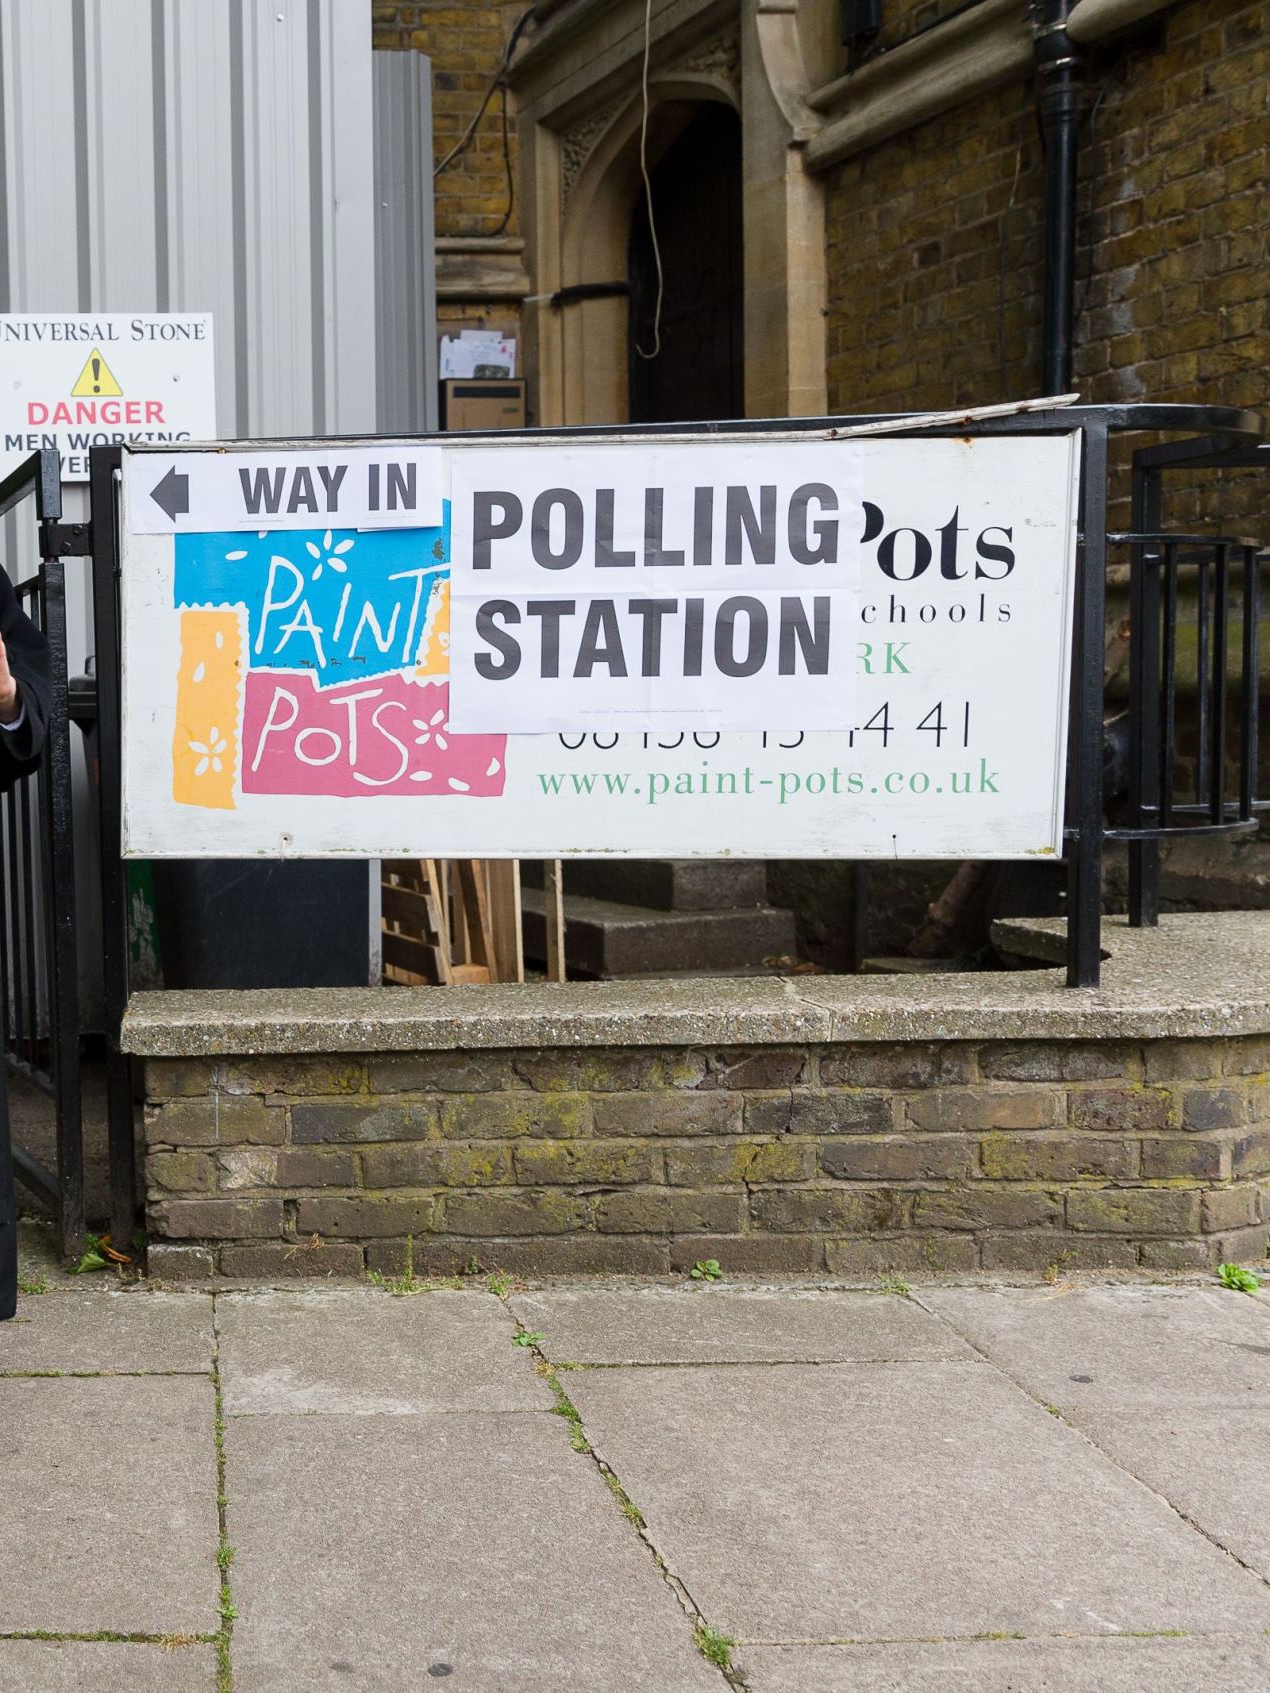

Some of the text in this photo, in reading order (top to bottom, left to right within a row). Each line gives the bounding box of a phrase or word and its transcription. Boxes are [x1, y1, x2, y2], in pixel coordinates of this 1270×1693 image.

[131, 319, 205, 342] STONE
[27, 400, 165, 425] DANGER
[4, 431, 191, 451] MEN WORKING
[238, 462, 417, 515] WAY IN
[472, 482, 840, 570] POLLING
[254, 555, 450, 668] PAINT
[860, 592, 1012, 624] chools
[473, 595, 831, 681] STATION
[856, 641, 913, 675] RK
[251, 686, 409, 786] POTS
[915, 701, 970, 748] 41
[537, 758, 1001, 805] www.paint-pots.co.uk
